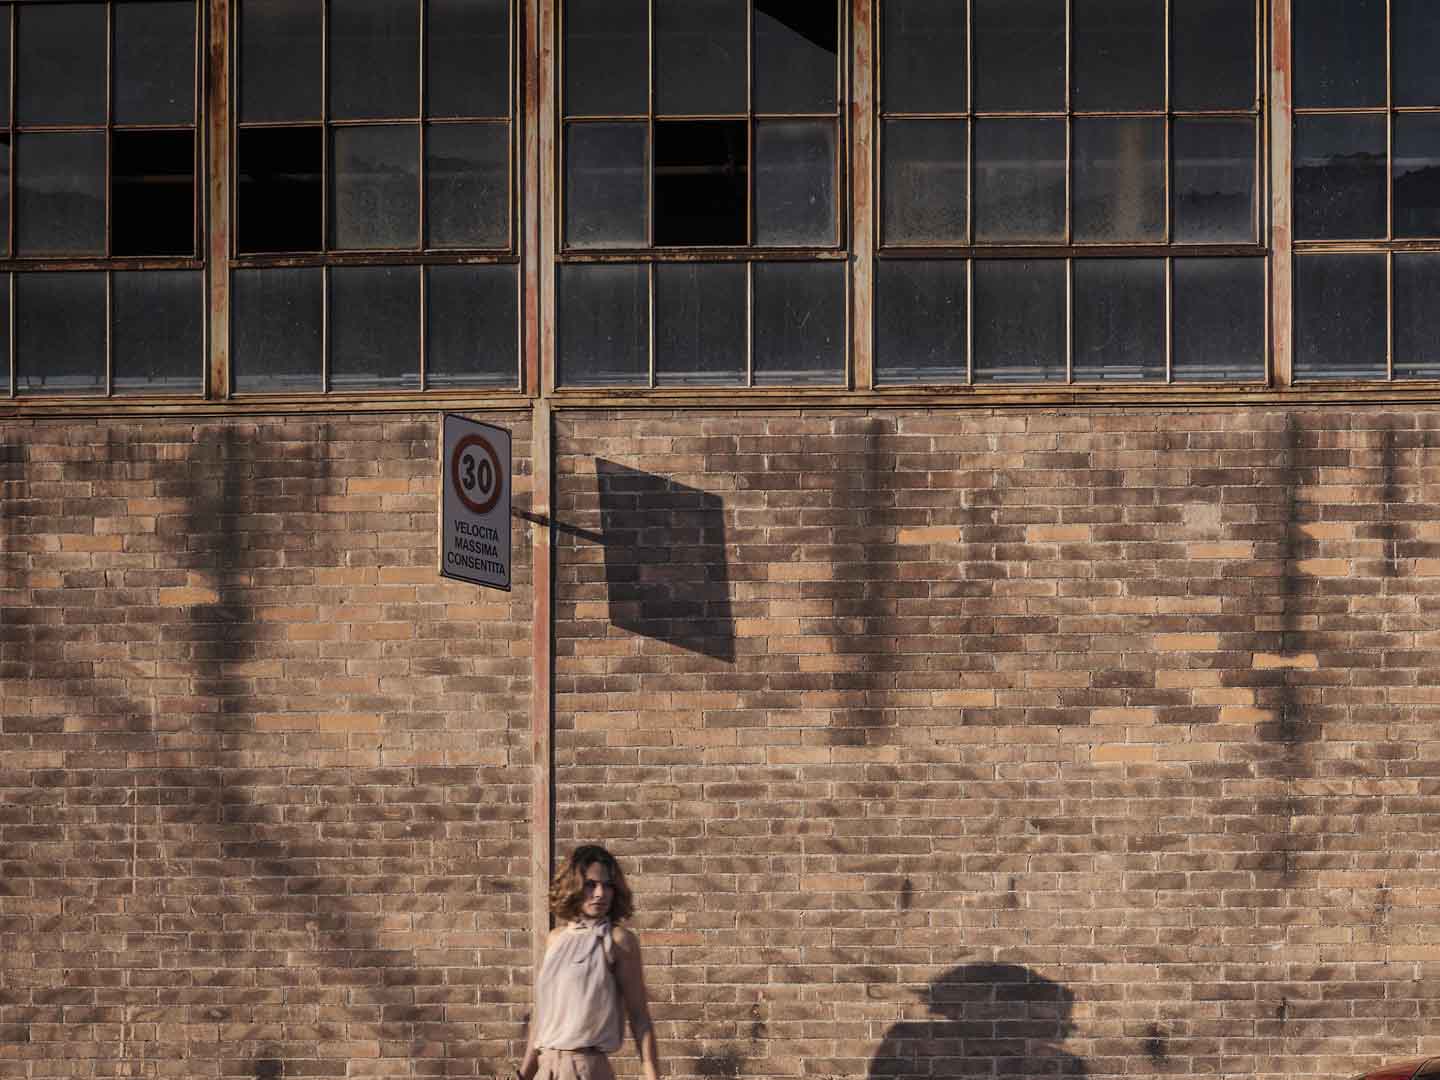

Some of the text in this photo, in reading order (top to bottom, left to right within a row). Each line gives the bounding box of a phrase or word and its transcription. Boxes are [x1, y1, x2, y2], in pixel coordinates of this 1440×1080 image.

[462, 454, 493, 495] 30
[454, 535, 498, 558] MASSIMA
[447, 551, 506, 576] CONSENTITA
